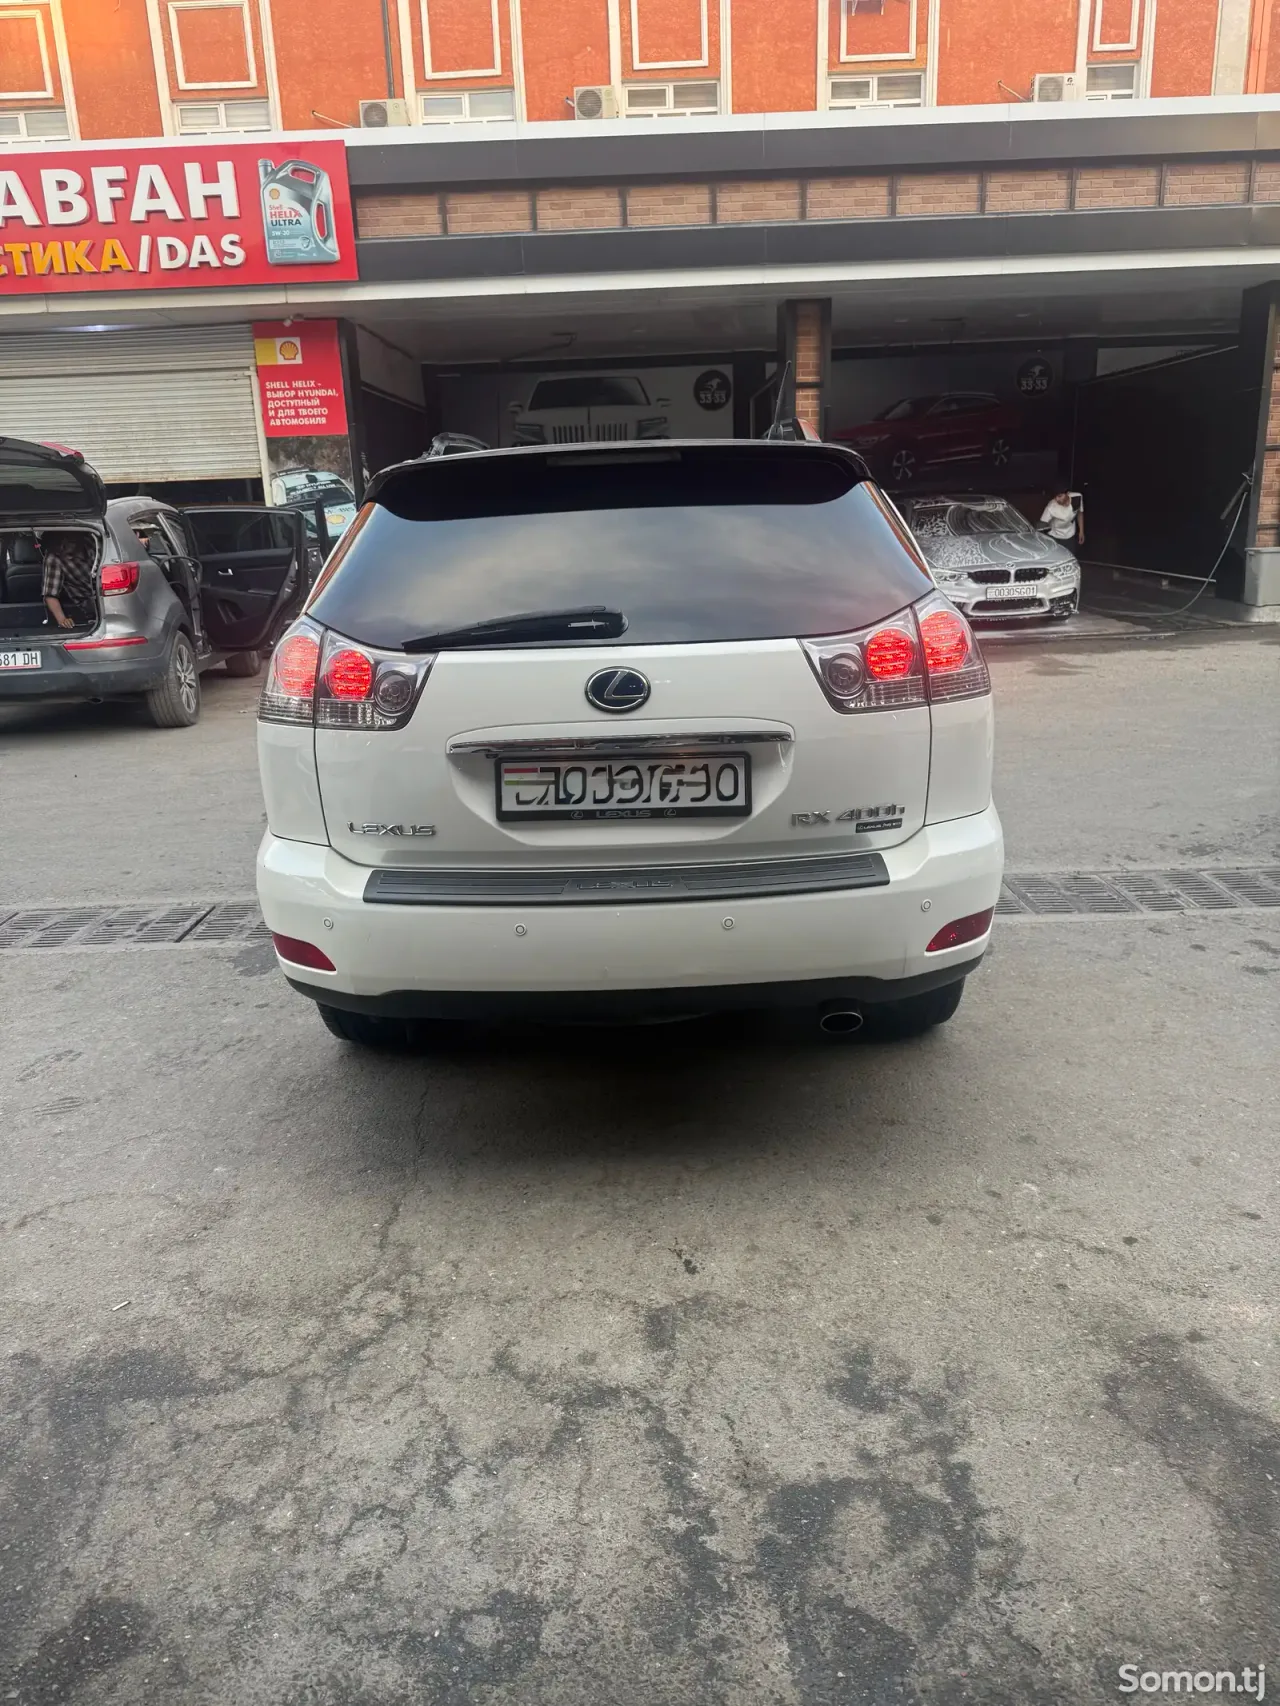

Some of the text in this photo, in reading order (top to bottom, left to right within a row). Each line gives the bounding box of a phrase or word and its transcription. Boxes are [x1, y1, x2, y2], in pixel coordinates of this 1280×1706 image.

[270, 209, 303, 219] HELIX
[271, 219, 302, 227] ULTRA
[265, 381, 289, 389] SHELL
[292, 380, 315, 388] HELIX
[266, 390, 295, 398] ВЫБОР
[268, 397, 320, 408] ДОСТУПНЫЙ
[278, 409, 295, 418] ДЛЯ
[270, 417, 327, 426] АВТОМОБИЛЯ
[0, 652, 38, 666] 81 DH
[596, 810, 651, 818] LEXUS
[791, 810, 831, 827] RX
[347, 821, 436, 836] LEXUS
